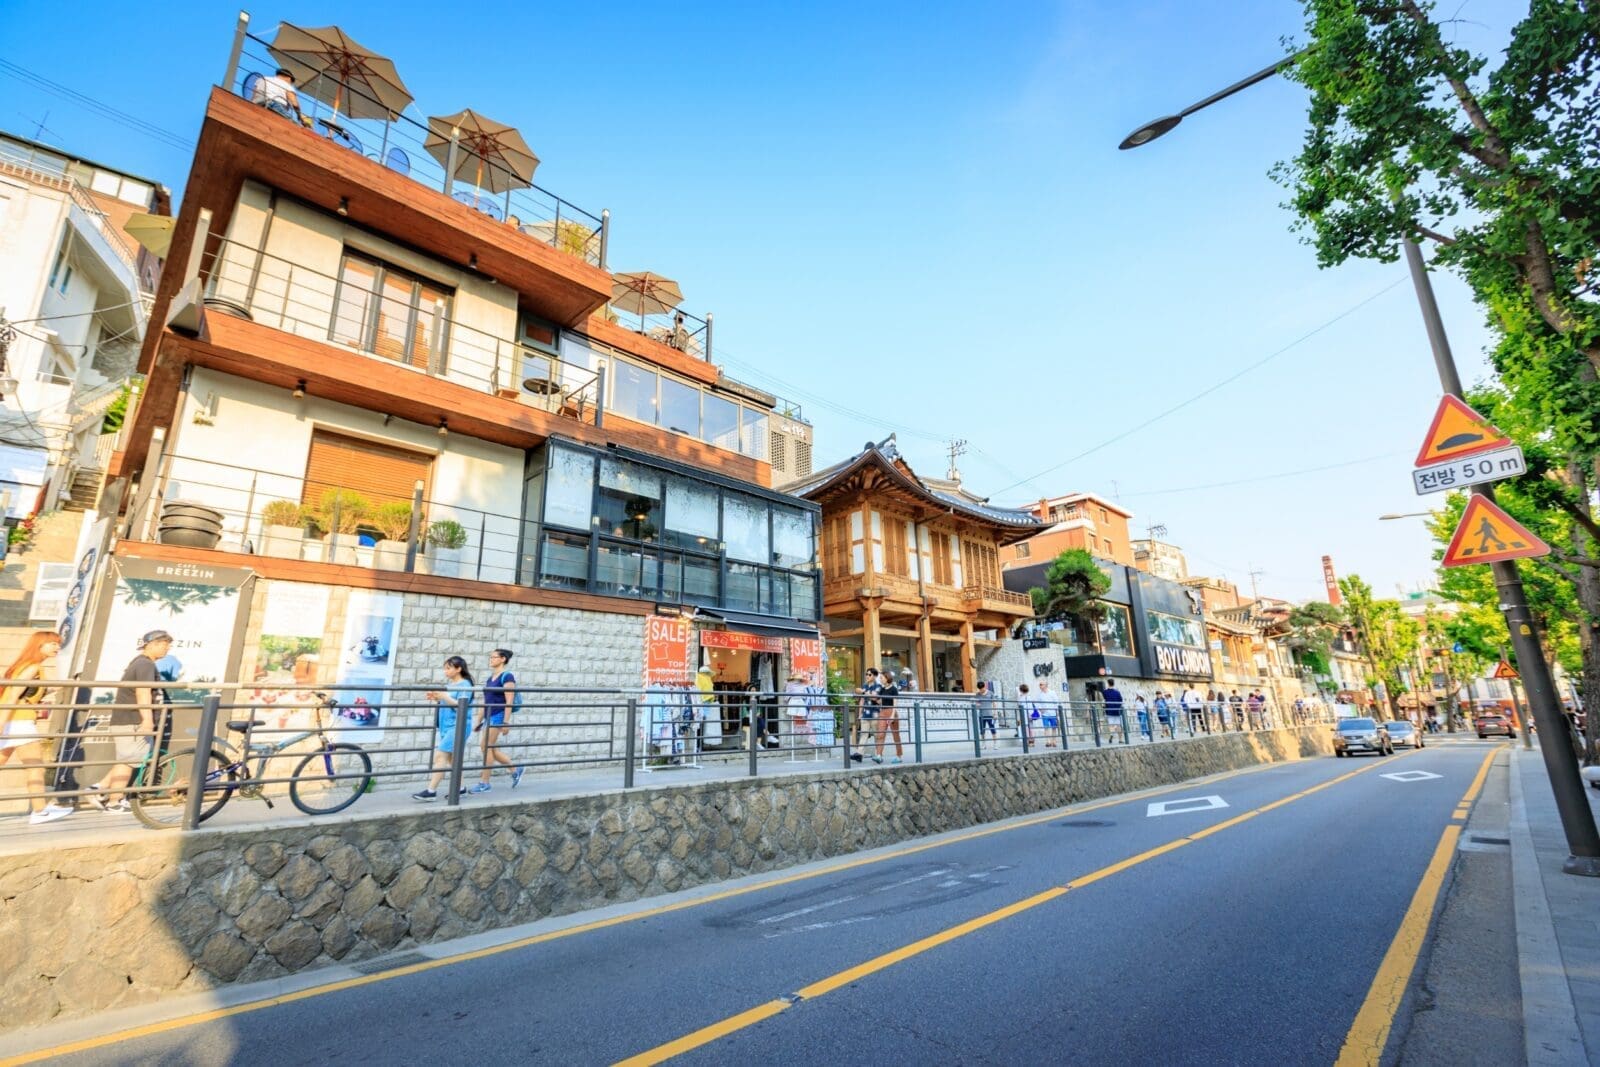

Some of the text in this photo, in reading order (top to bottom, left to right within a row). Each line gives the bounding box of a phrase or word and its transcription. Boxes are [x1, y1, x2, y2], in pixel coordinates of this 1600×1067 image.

[1418, 468, 1456, 489] 전방
[1463, 460, 1493, 478] 50
[156, 566, 215, 579] BREEZIN
[652, 620, 685, 643] SALE
[136, 638, 202, 648] BZIN
[794, 639, 819, 657] SALE
[667, 660, 684, 668] TOP
